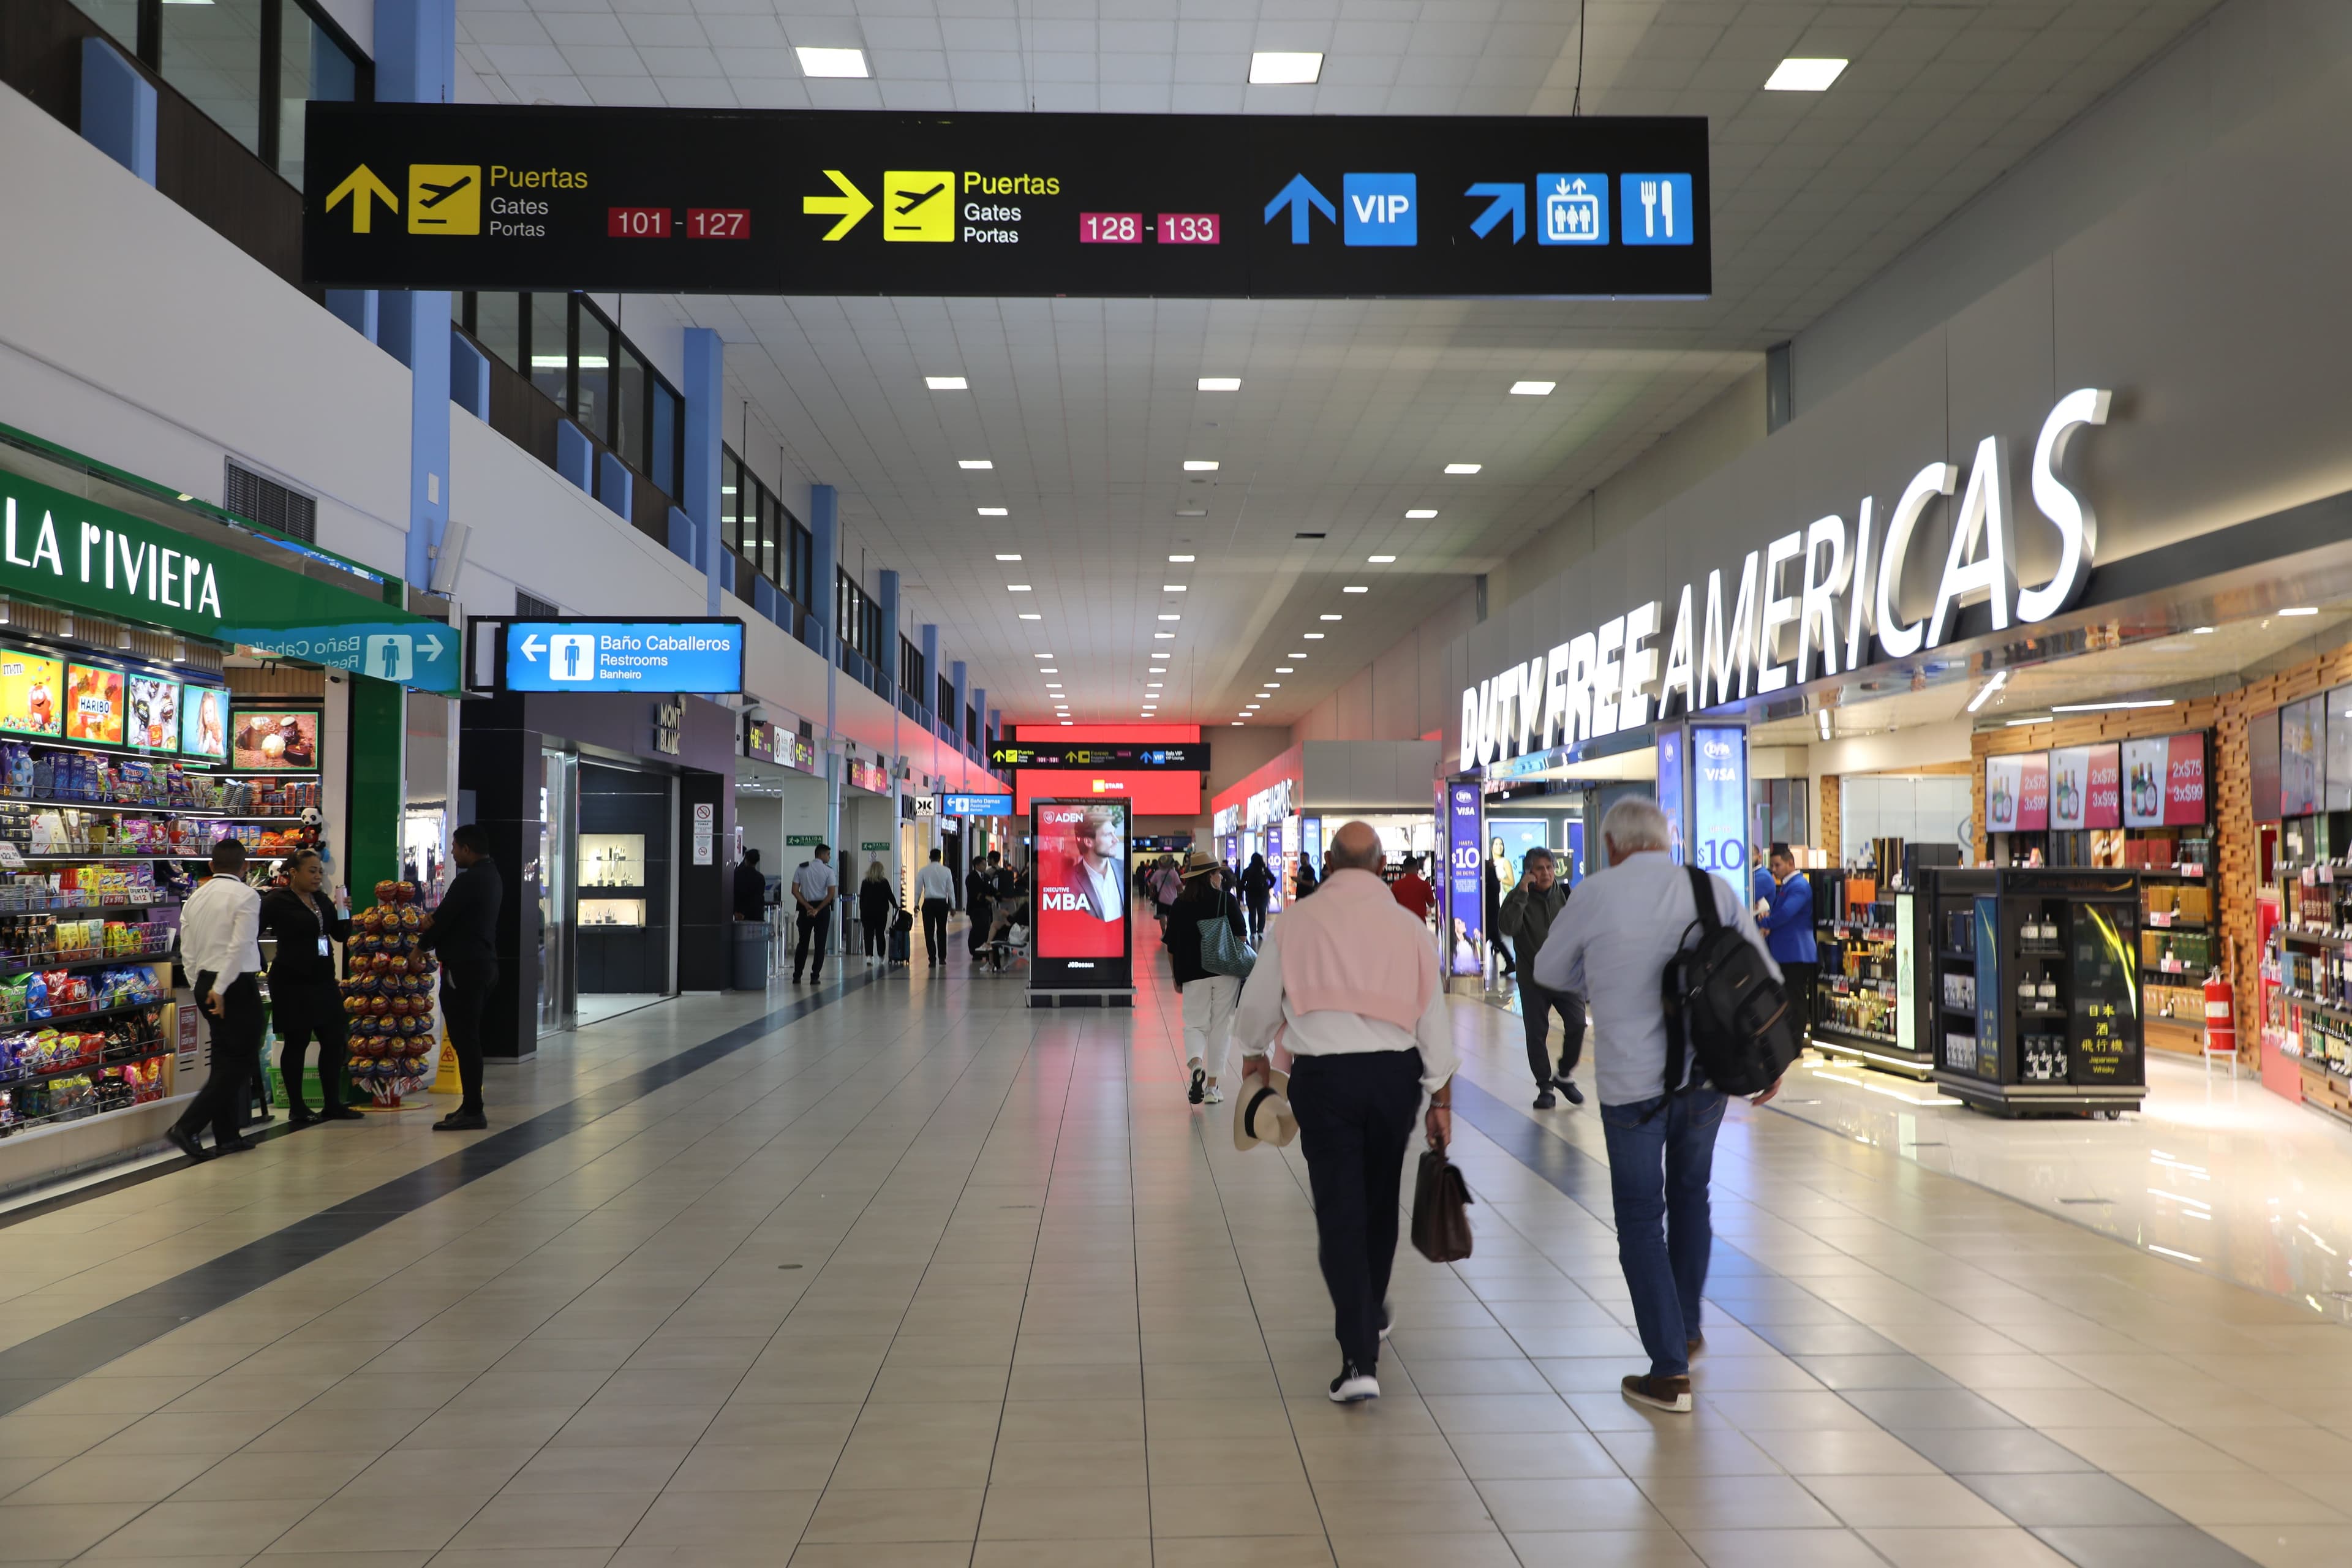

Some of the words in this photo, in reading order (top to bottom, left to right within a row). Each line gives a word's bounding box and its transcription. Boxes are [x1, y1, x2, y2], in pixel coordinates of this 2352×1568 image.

[491, 166, 588, 189] Puertas
[964, 172, 1060, 195] Puertas
[491, 197, 549, 216] Gates
[964, 204, 1022, 222] Gates
[1352, 195, 1409, 223] VIP
[490, 222, 546, 238] Portas
[618, 213, 660, 234] 101
[695, 214, 744, 236] 127
[1087, 217, 1136, 241] 128
[1165, 218, 1213, 241] 133
[964, 227, 1019, 244] Portas
[5, 497, 63, 576] LA
[1459, 656, 1546, 772] DUTY
[1542, 600, 1662, 739] FREE
[1658, 387, 2112, 721] AMERICAS
[600, 635, 641, 652] Baño
[646, 635, 730, 652] Caballeros
[600, 654, 668, 666] Restrooms
[600, 669, 642, 679] Banheiro
[81, 698, 110, 714] HARIBO
[661, 703, 680, 731] MONT
[660, 728, 680, 755] BLANC
[1704, 767, 1736, 781] VISA
[2092, 769, 2117, 786] 2x$75
[2173, 759, 2202, 778] 2x$75
[2024, 775, 2047, 791] 2x$75
[2092, 791, 2117, 807] 3x$99
[2173, 784, 2203, 803] 3x$99
[1456, 807, 1475, 815] VISA
[2024, 796, 2047, 811] 3x$99
[1055, 813, 1083, 823] ADEN
[1452, 847, 1480, 869] $10
[1698, 839, 1745, 872] $10
[1042, 893, 1091, 911] MBA
[2089, 1055, 2119, 1065] Japanese
[2093, 1066, 2116, 1075] Whisky
